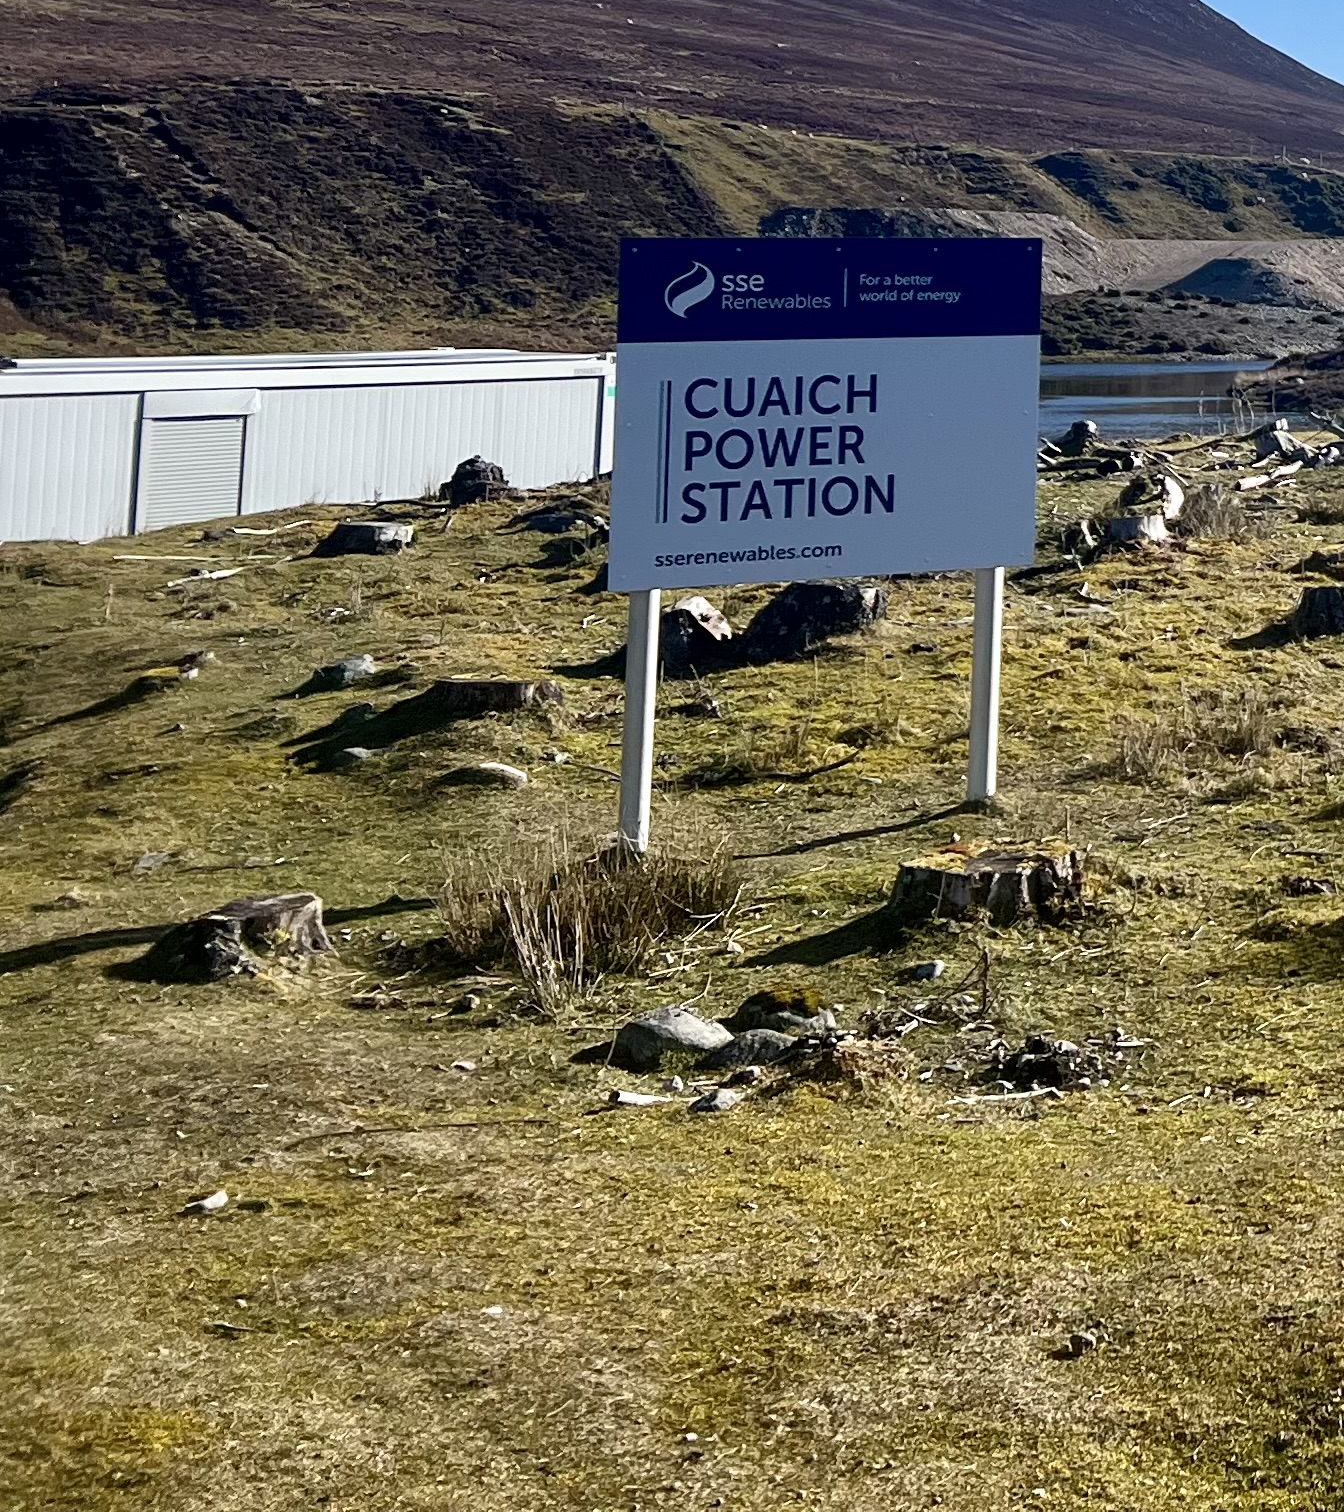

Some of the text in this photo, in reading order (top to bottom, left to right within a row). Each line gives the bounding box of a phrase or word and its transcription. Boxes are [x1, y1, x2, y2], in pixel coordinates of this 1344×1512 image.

[722, 275, 764, 292] sse
[860, 273, 934, 285] For a better
[722, 294, 831, 309] Renewables
[859, 289, 961, 304] world of energy
[685, 374, 877, 419] CUAICH
[685, 425, 865, 471] POWER
[681, 473, 894, 523] STATION
[655, 544, 842, 567] sserenewables.com
